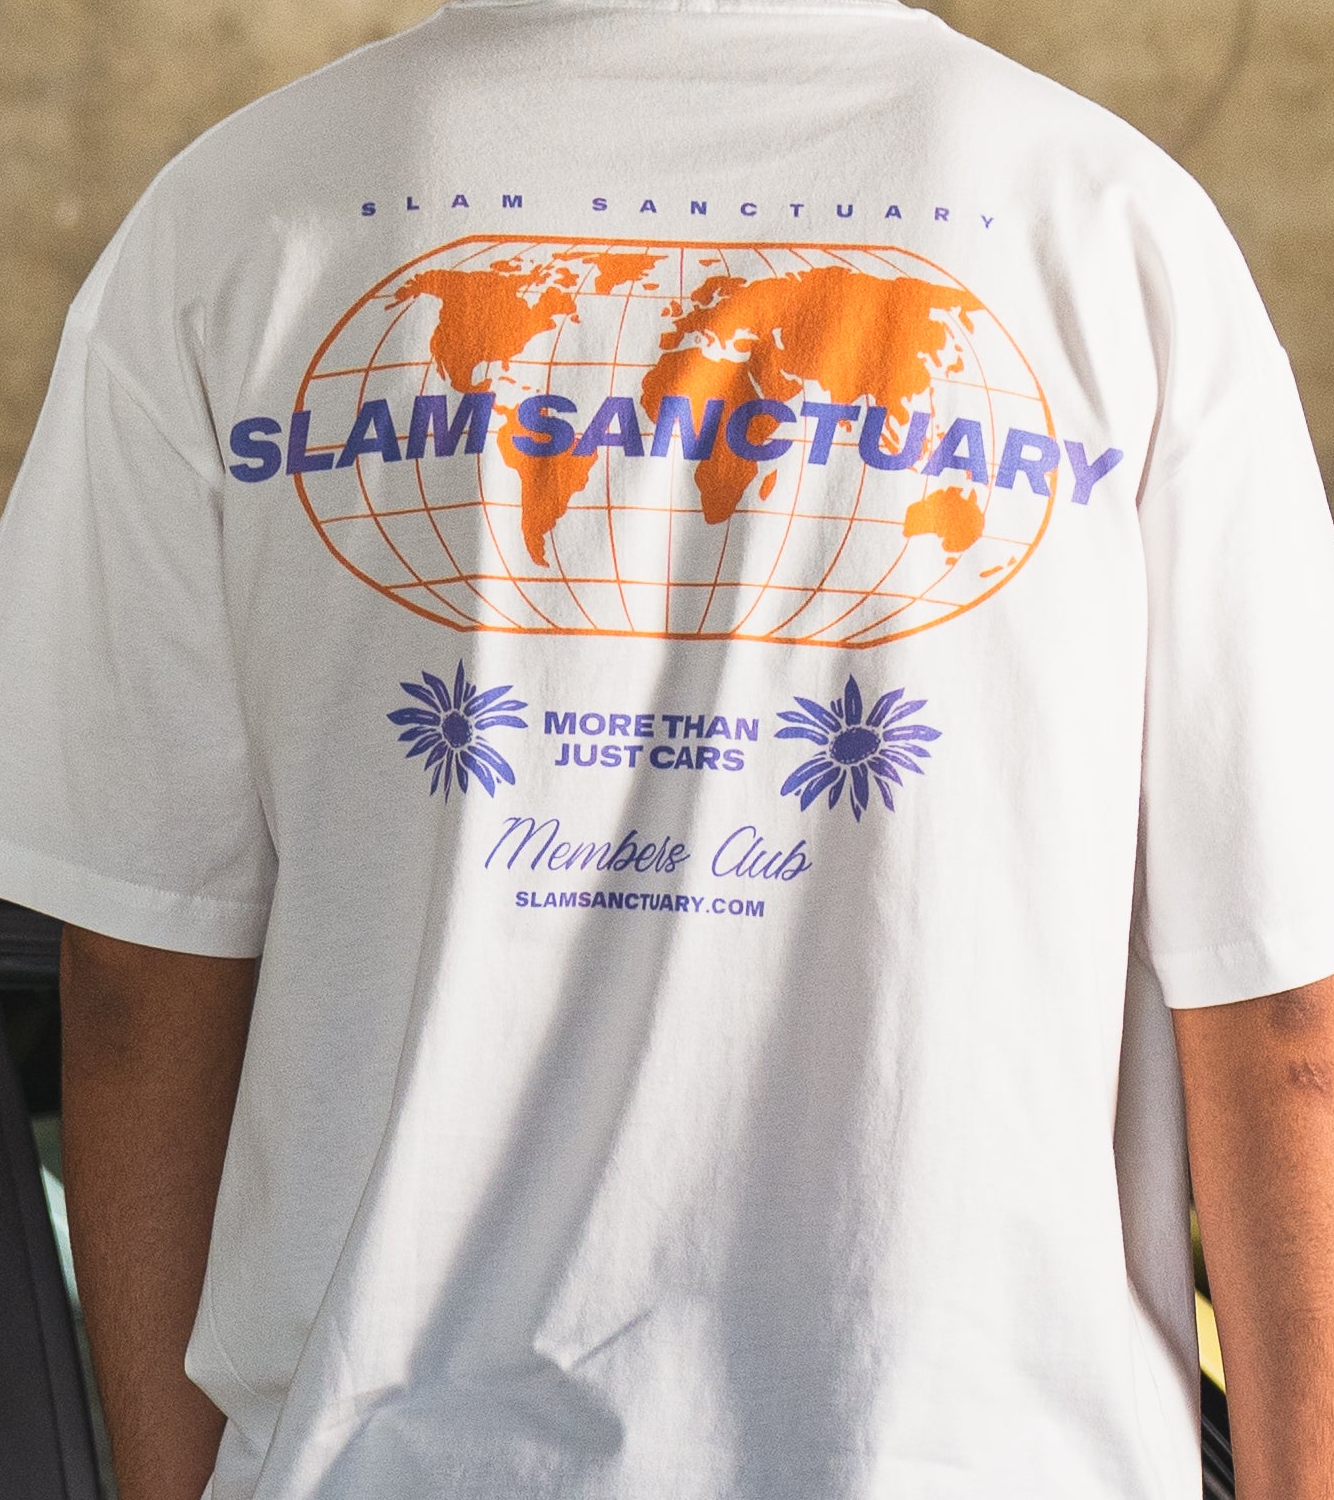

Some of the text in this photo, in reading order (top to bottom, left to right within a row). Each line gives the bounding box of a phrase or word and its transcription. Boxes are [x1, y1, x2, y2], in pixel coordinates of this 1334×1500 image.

[361, 193, 994, 230] SLAM SANCTUARY
[229, 392, 1124, 506] SLAM SANCTUARY
[543, 710, 760, 742] MORE THAN
[554, 743, 745, 772] JUST CARS
[484, 816, 813, 882] Members Club
[515, 890, 765, 918] SLAMSANCTUARY.COM
